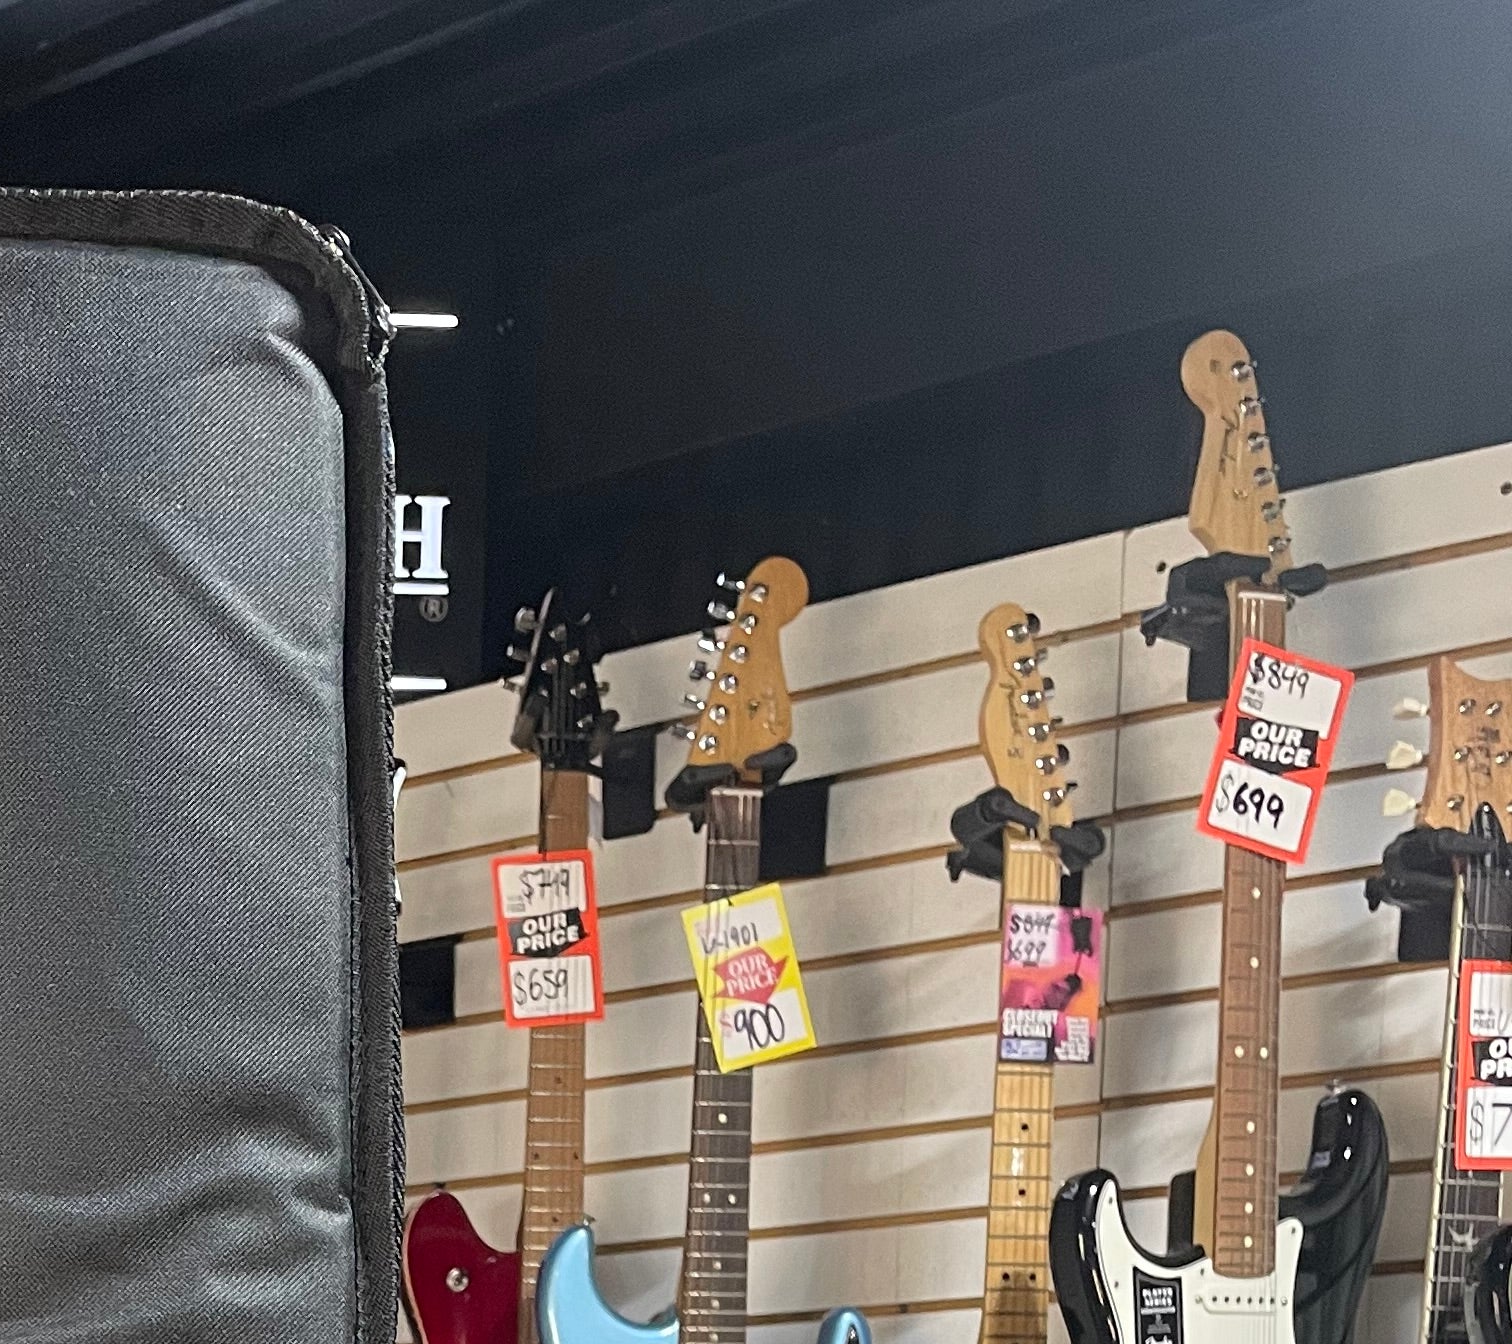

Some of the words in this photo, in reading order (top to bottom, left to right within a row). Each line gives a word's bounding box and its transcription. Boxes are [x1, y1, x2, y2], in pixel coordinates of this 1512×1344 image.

[1249, 655, 1310, 698] $849
[1251, 720, 1303, 748] OUR
[1237, 740, 1312, 768] PRICE
[1215, 773, 1285, 830] $699
[522, 912, 568, 936] OUR
[516, 925, 582, 954] PRICE
[727, 950, 769, 978] OUR
[513, 968, 569, 1006] $659
[725, 967, 779, 998] PRICE
[719, 1003, 786, 1051] $900
